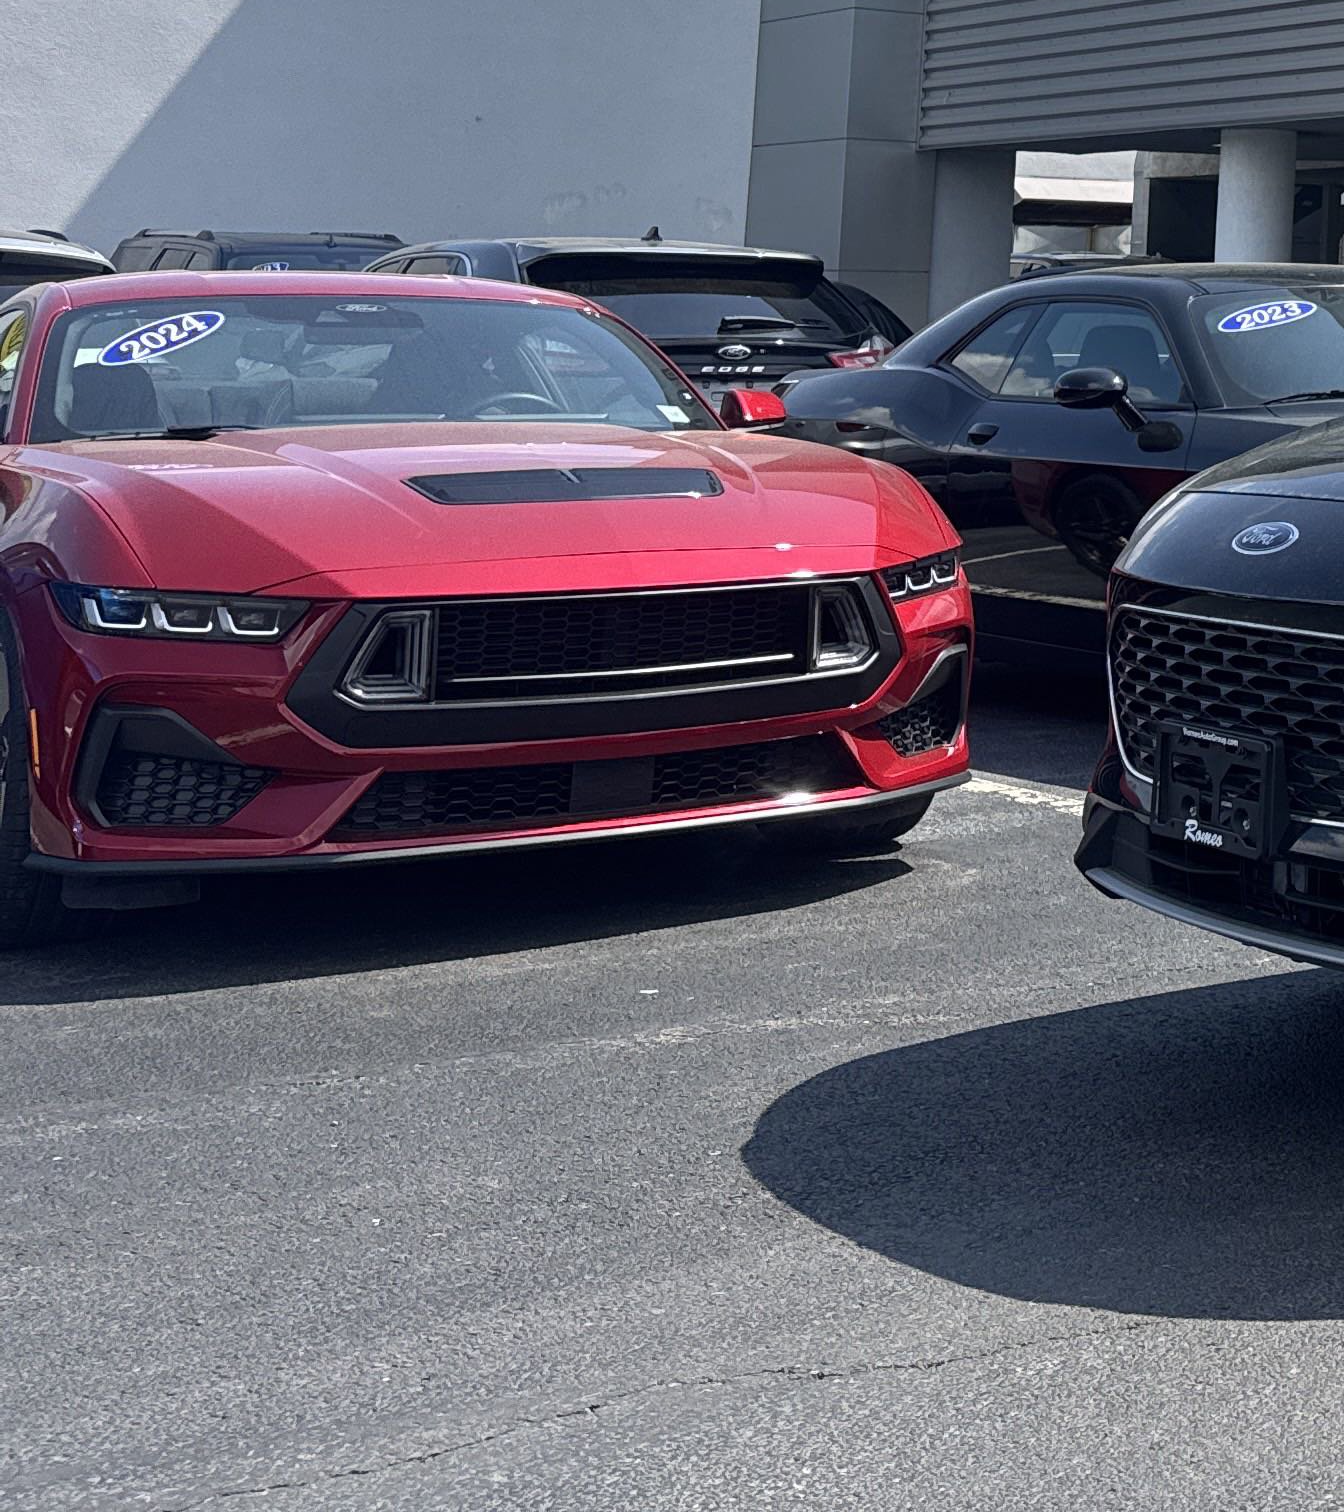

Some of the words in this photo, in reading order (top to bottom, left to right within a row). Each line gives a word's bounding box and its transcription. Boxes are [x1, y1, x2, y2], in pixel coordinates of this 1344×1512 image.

[1236, 303, 1302, 330] 2023
[120, 313, 208, 360] 2024
[1184, 819, 1223, 847] Romeo
